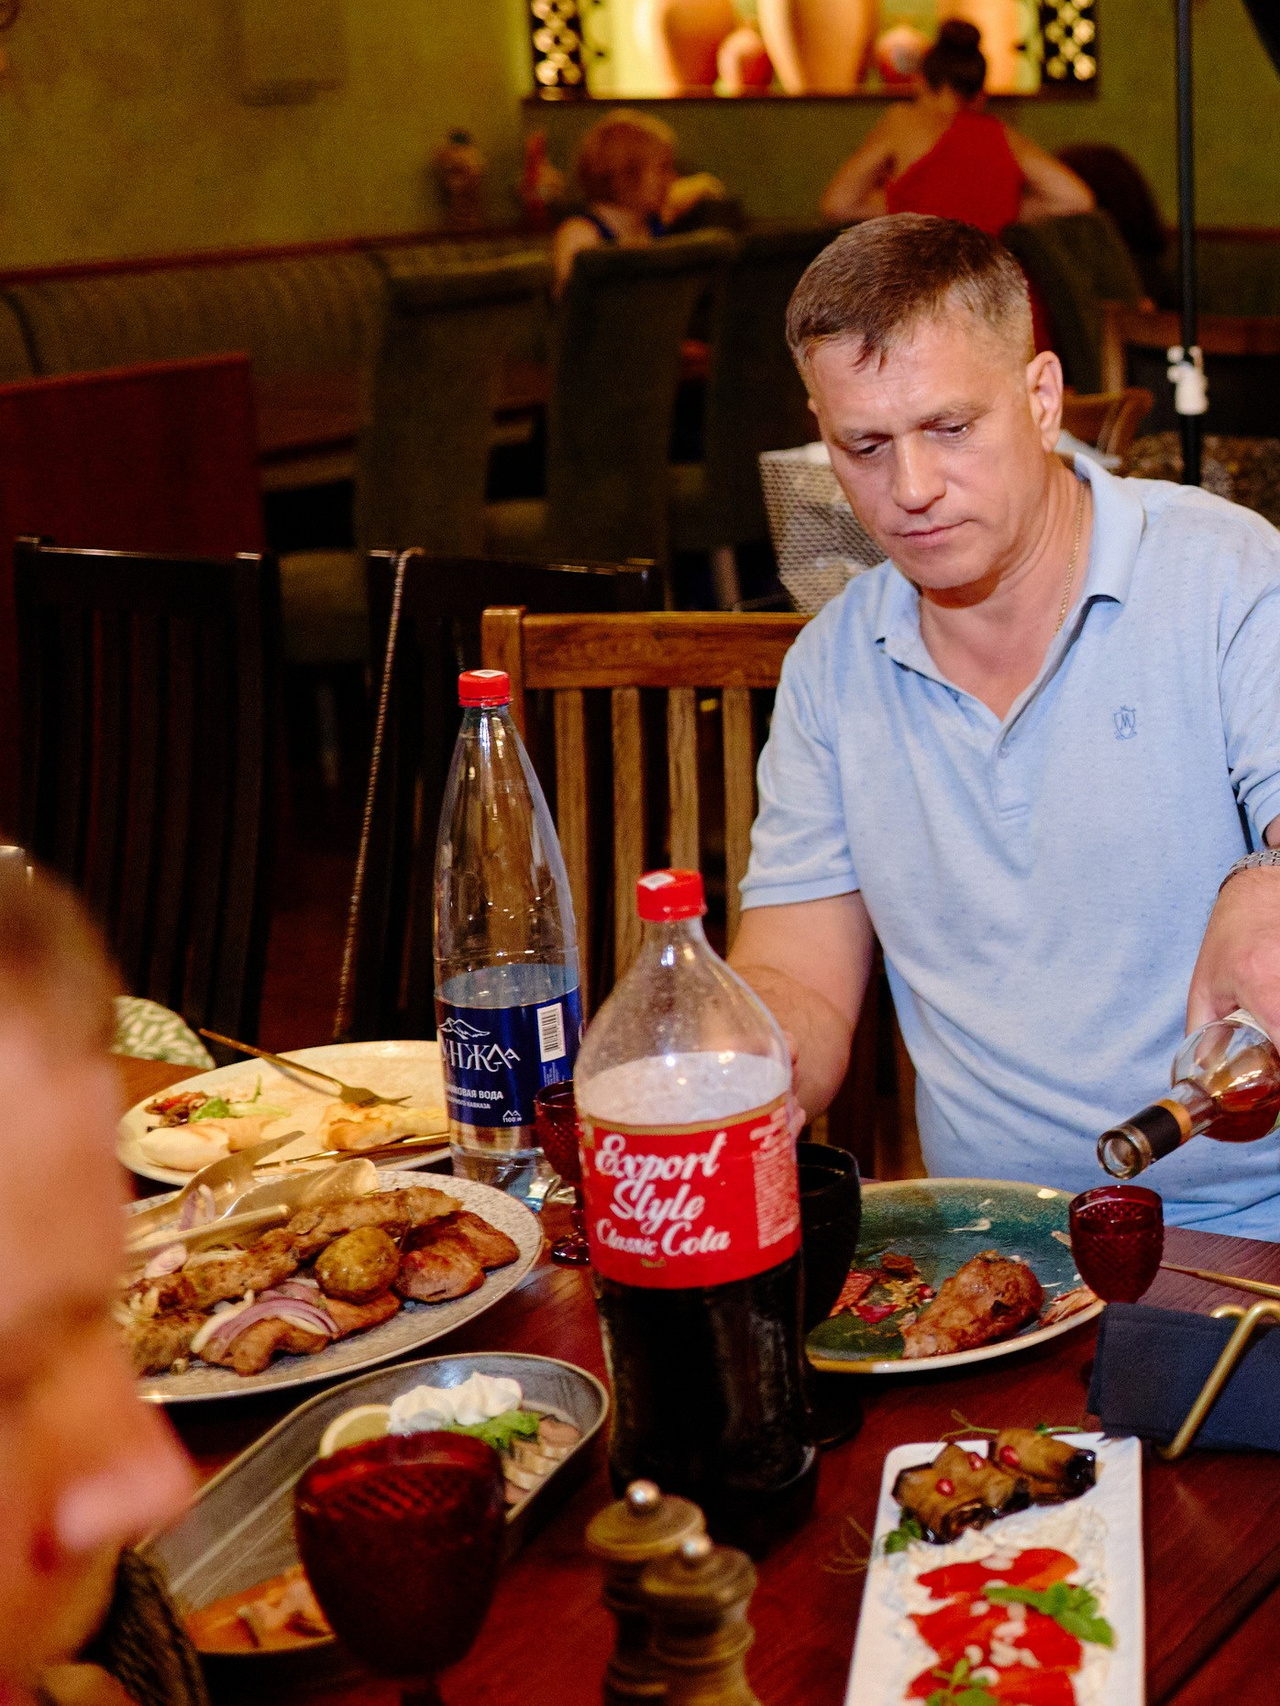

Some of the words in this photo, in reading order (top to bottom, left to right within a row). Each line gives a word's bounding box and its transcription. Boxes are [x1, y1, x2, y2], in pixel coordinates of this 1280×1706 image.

[478, 1089, 504, 1101] ВОДА
[595, 1131, 727, 1201] Export
[609, 1178, 706, 1235] Style
[596, 1218, 658, 1255] Classic
[661, 1221, 731, 1257] Cola
